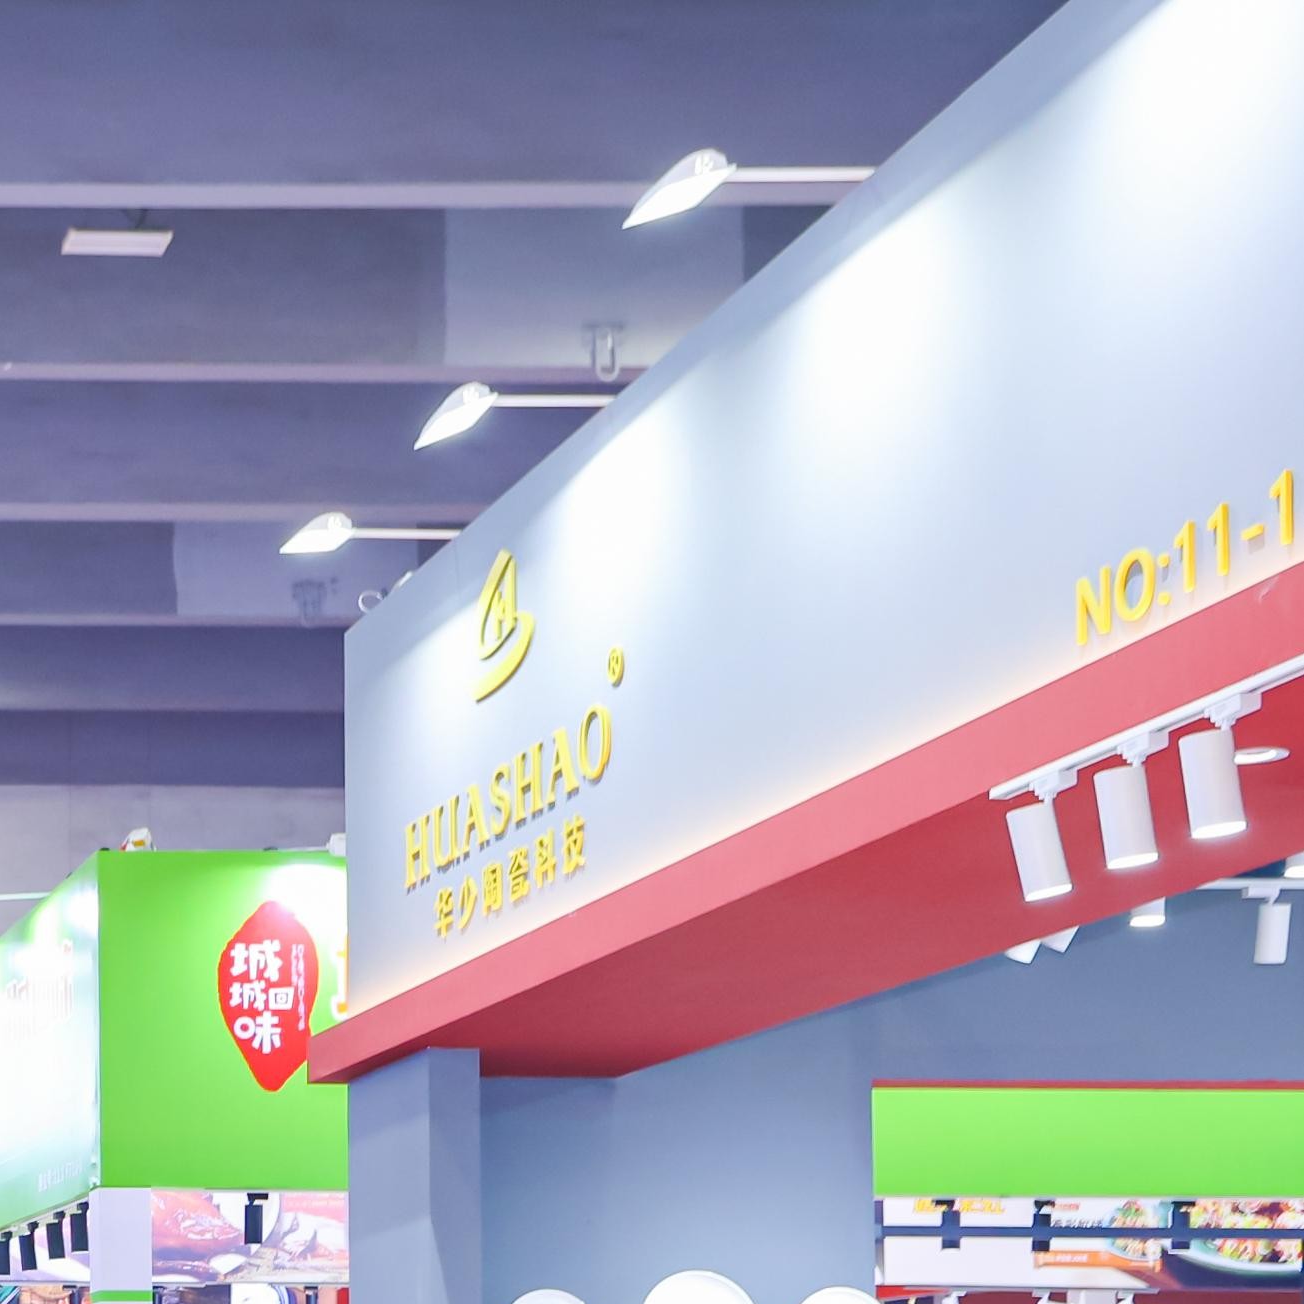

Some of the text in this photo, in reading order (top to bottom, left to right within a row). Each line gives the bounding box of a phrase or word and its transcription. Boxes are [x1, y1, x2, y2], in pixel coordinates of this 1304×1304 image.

[404, 702, 613, 889] HUASHAO
[434, 815, 586, 938] 华少陶瓷科技
